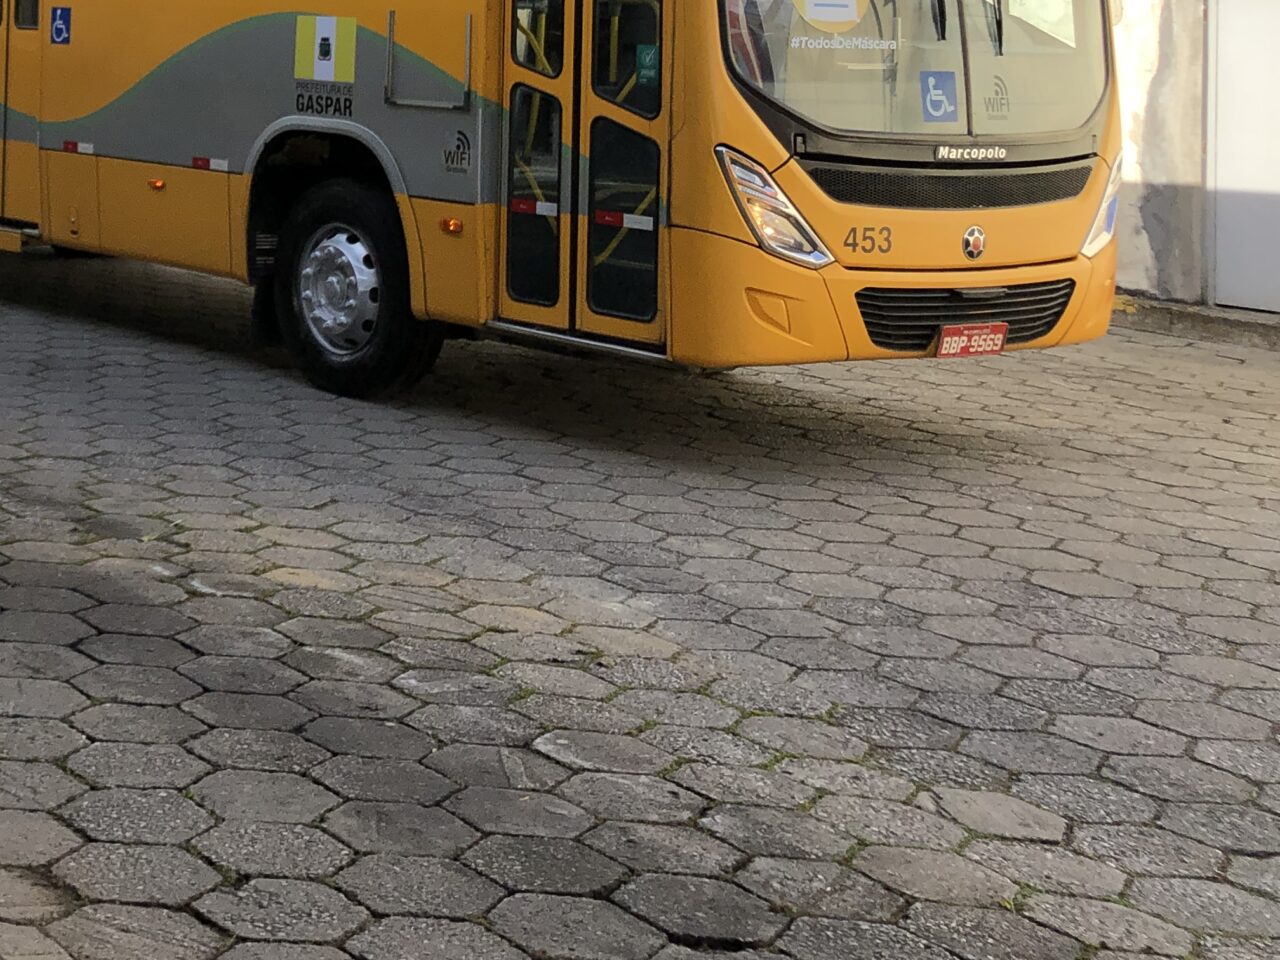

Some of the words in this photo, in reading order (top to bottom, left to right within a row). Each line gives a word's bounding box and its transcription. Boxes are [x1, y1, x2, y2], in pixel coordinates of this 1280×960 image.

[791, 36, 897, 49] #TodosDeMáscara
[295, 82, 342, 94] PREFEITURA
[342, 85, 354, 96] DE
[296, 93, 353, 117] GASPAR
[983, 97, 1010, 112] WIFI
[443, 149, 471, 166] WIFI
[938, 146, 1007, 160] Marcopolo
[843, 226, 893, 253] 453
